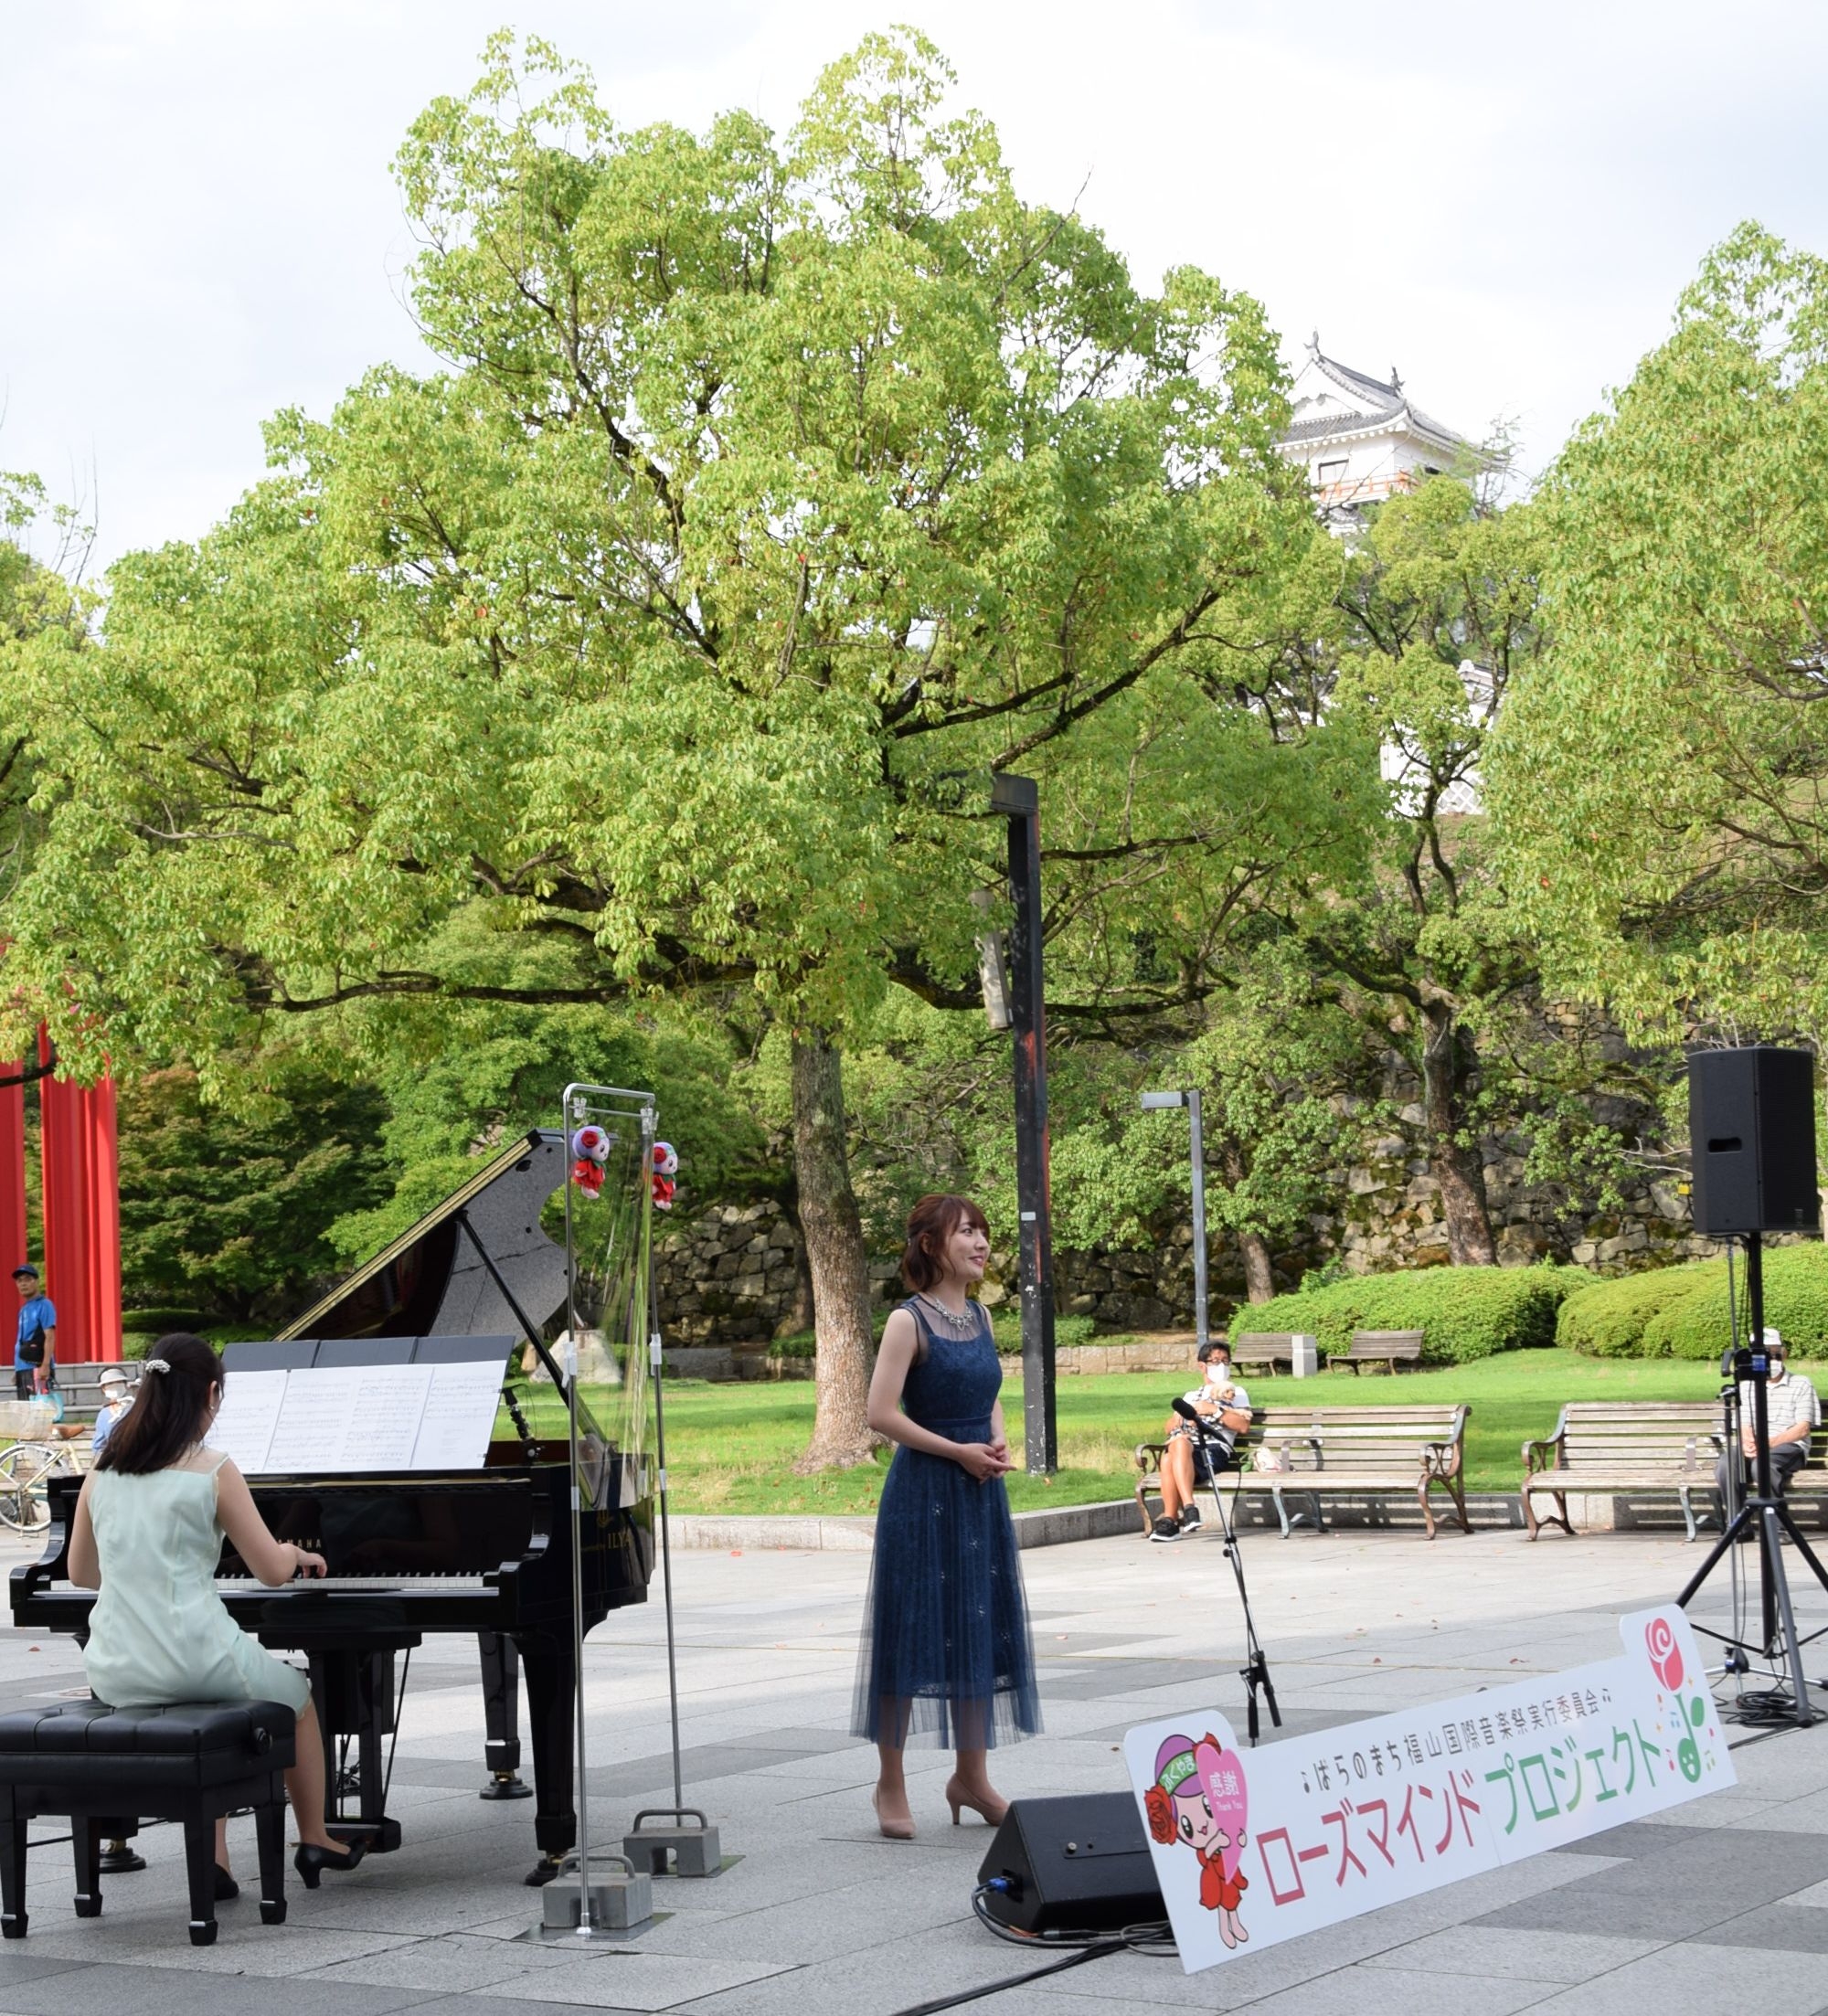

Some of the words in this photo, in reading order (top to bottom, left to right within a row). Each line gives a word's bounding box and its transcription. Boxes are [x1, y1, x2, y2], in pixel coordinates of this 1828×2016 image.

[1313, 1688, 1600, 1792] ばらのまち福山国際音楽祭実行委員会
[1160, 1754, 1196, 1791] ふくやま
[1208, 1770, 1240, 1798] 感謝
